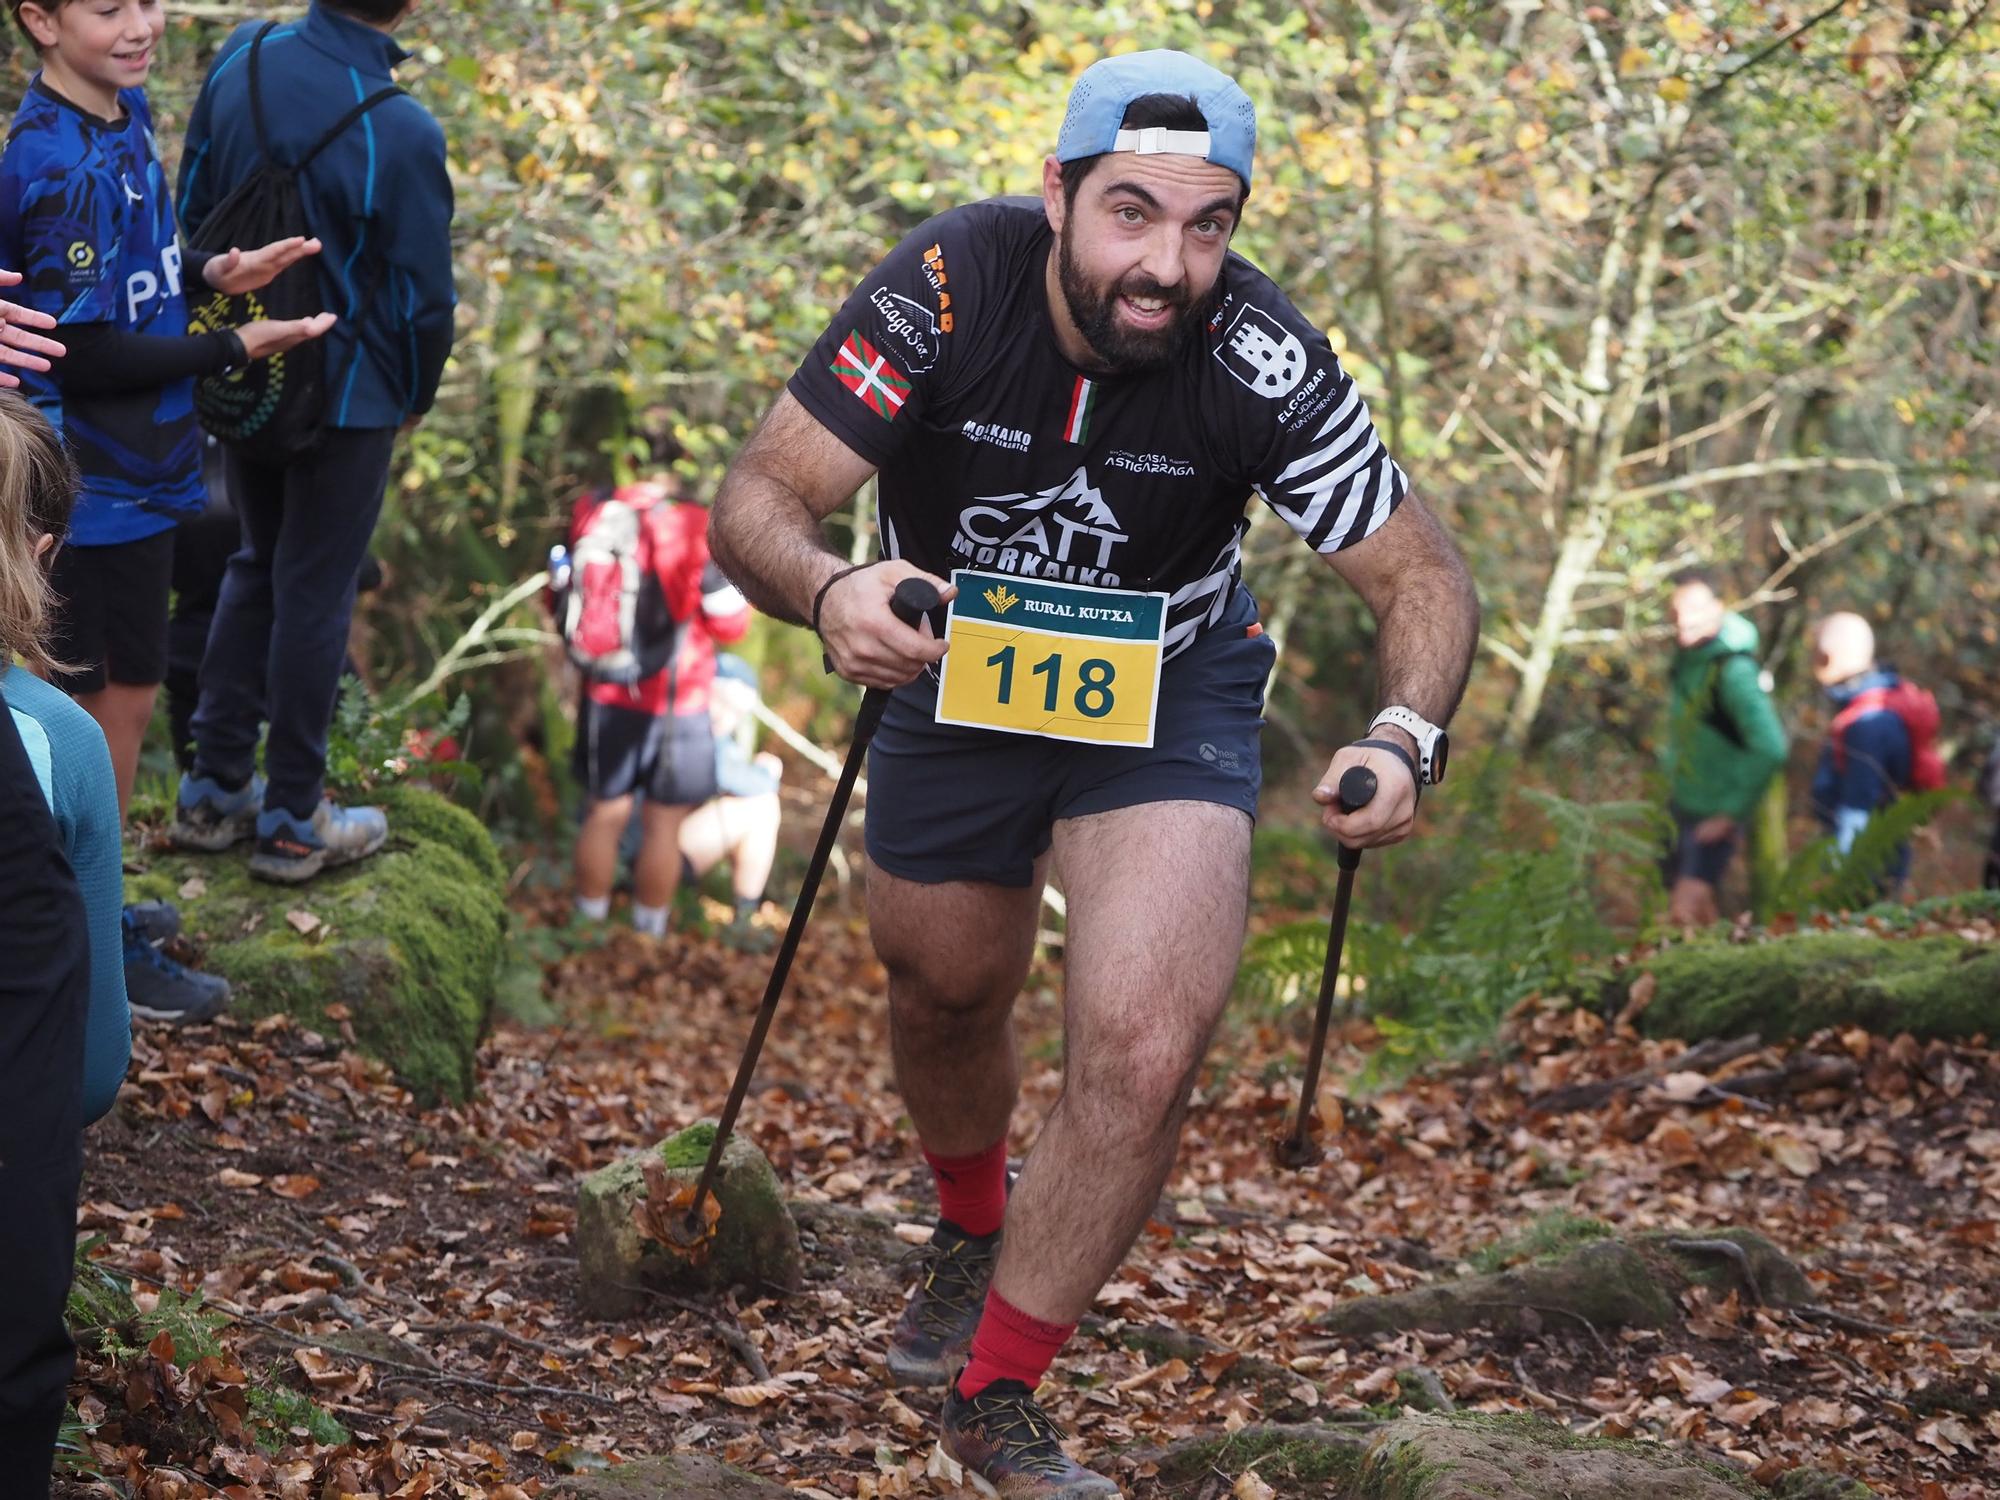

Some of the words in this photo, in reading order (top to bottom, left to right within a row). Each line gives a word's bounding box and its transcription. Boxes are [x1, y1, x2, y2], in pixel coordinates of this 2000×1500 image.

[1277, 368, 1327, 424] ELGOIBAR
[1286, 387, 1337, 434] AYUNTAMIENTO
[1296, 393, 1321, 415] UDALA
[1104, 457, 1195, 476] ASTIGARRAGA
[1138, 453, 1167, 463] CASA
[951, 530, 1121, 587] MORKAIKO
[959, 505, 1129, 569] CATT
[1024, 599, 1075, 617] RURAL
[1078, 607, 1134, 623] KUTXA
[986, 645, 1116, 718] 118
